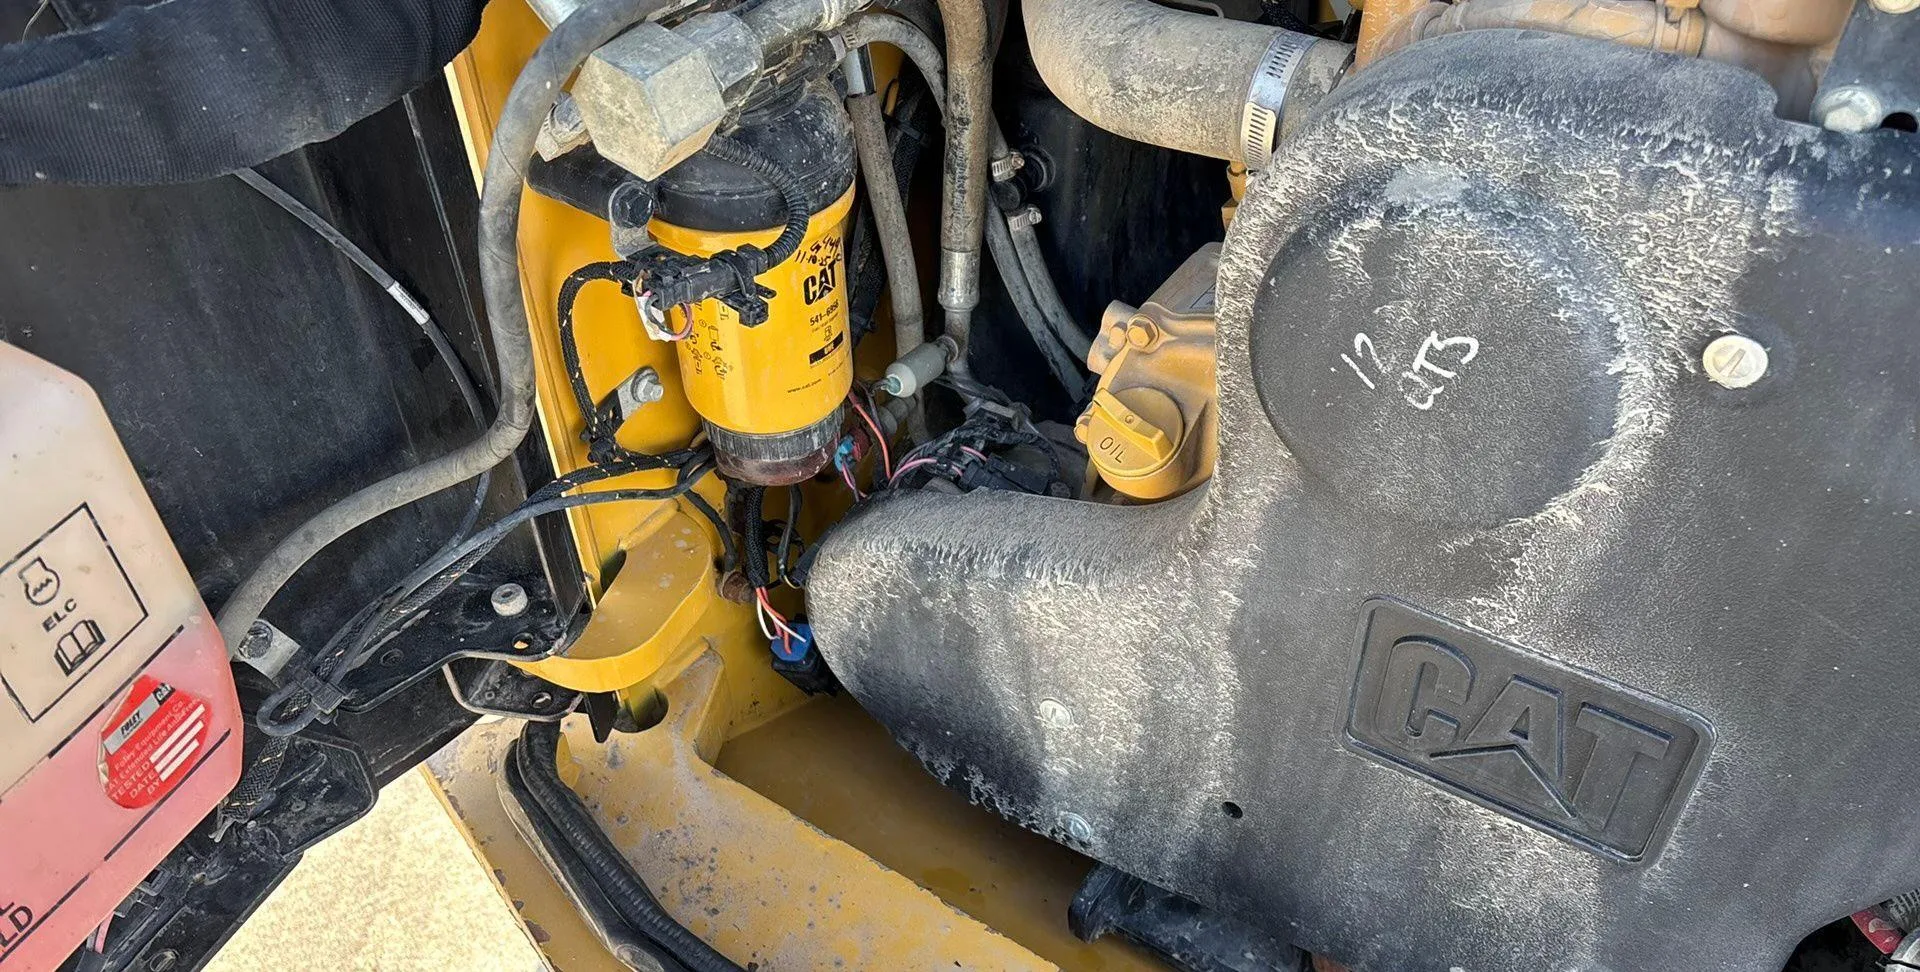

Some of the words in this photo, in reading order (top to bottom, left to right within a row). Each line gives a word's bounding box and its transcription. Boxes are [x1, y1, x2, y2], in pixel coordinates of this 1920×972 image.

[804, 260, 836, 305] CAT
[1100, 436, 1124, 463] OIL
[42, 598, 77, 632] ELC
[120, 710, 141, 735] FOLEY
[1375, 634, 1675, 832] CAT
[112, 761, 150, 800] TESTED
[129, 770, 156, 799] DATE
[147, 780, 161, 795] BY
